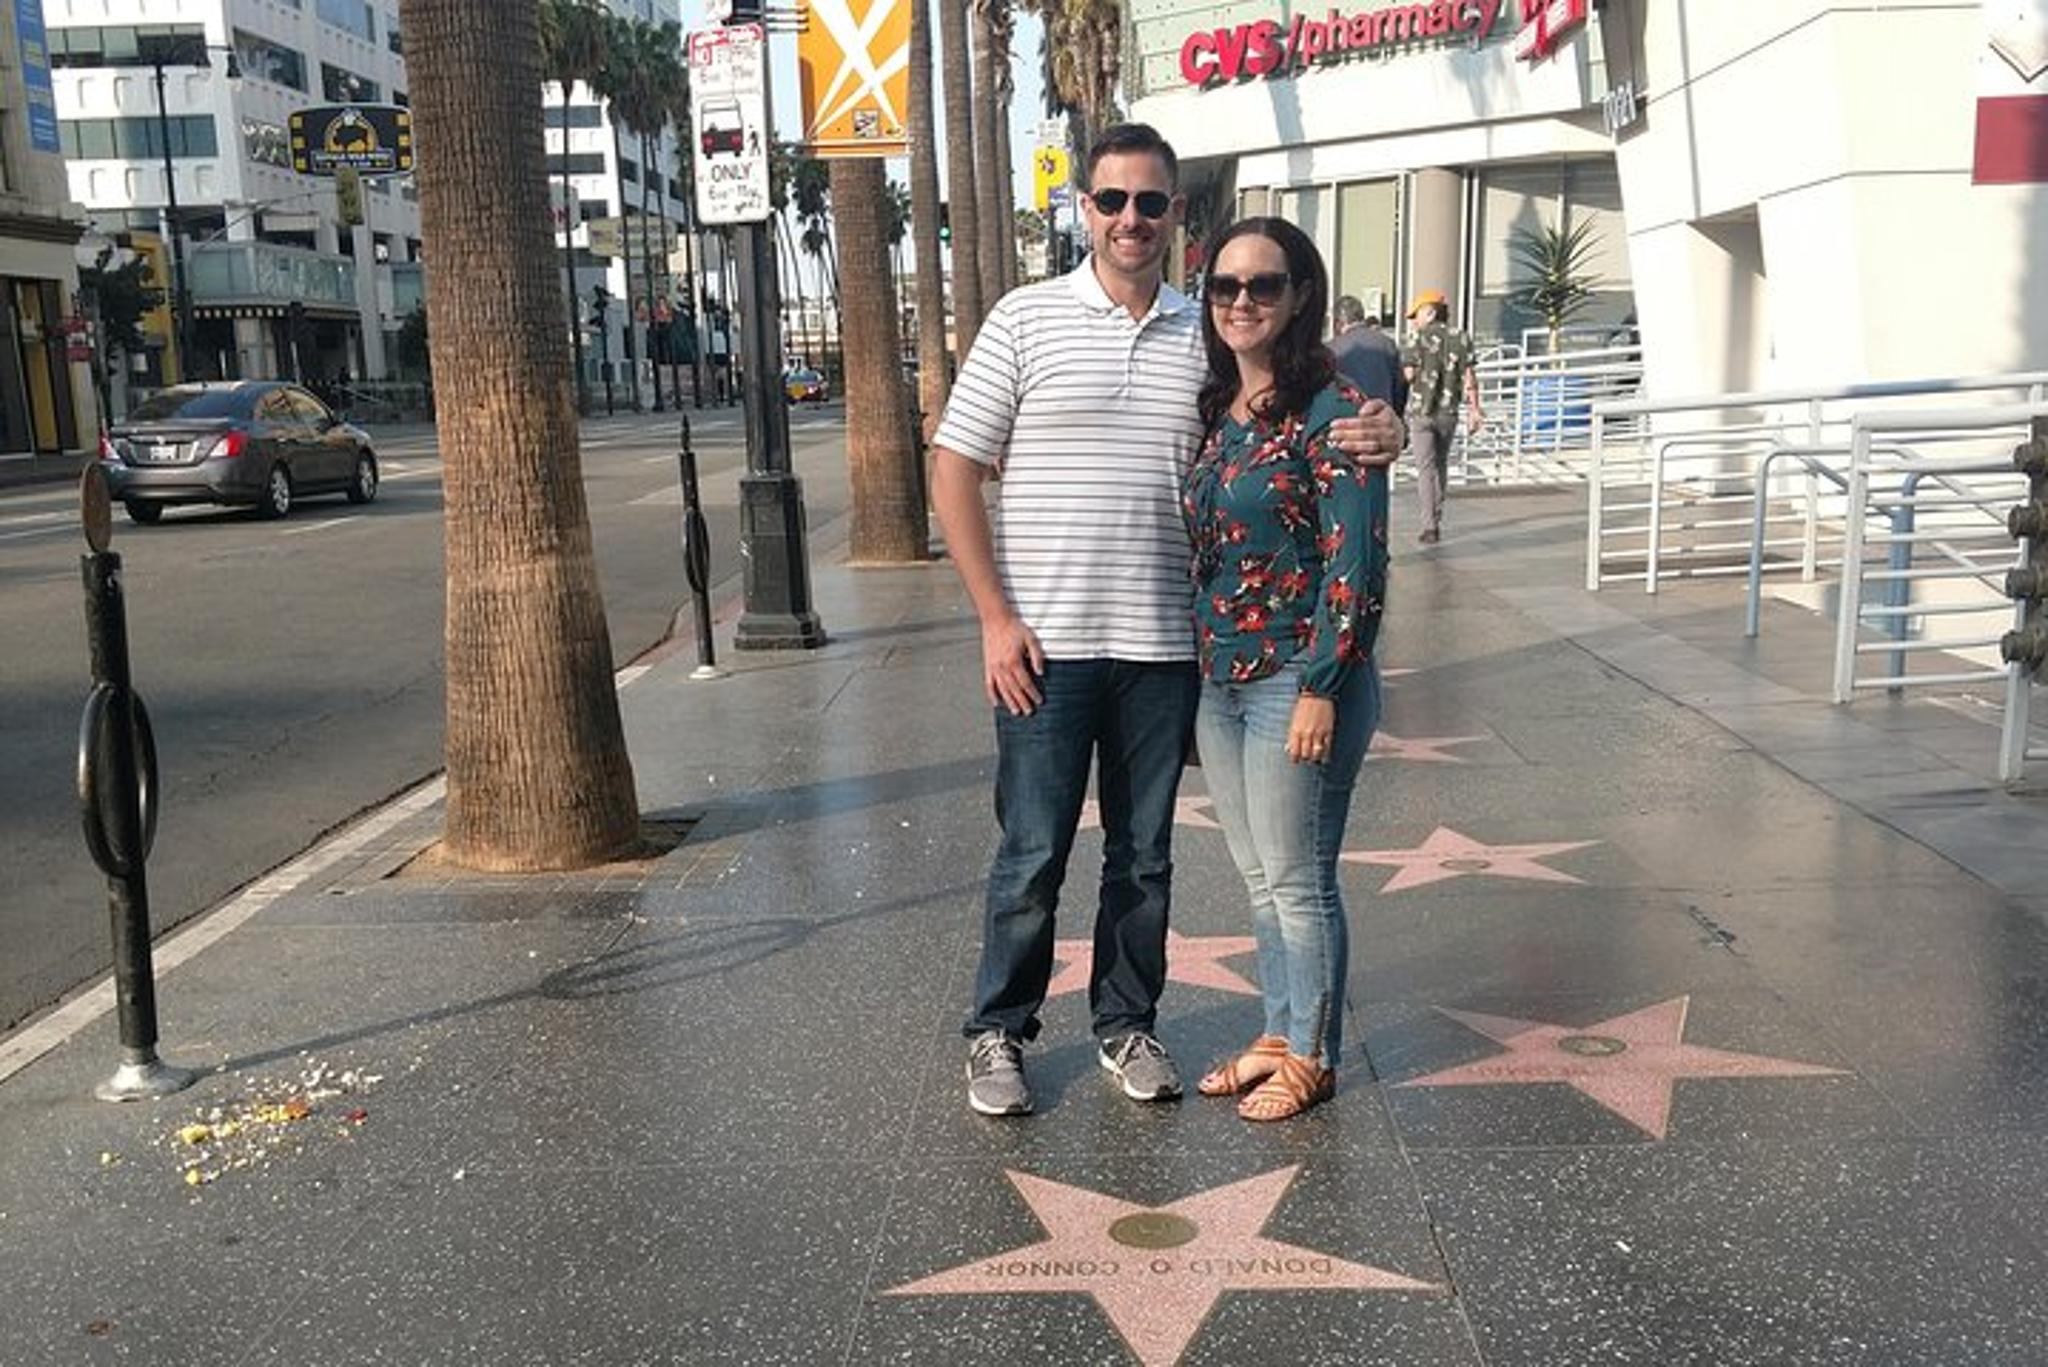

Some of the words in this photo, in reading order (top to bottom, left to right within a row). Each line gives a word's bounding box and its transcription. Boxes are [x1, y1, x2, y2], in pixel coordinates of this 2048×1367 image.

[711, 162, 752, 182] ONLY
[985, 1259, 1120, 1277] CONNOR
[1190, 1258, 1332, 1275] DONALD
